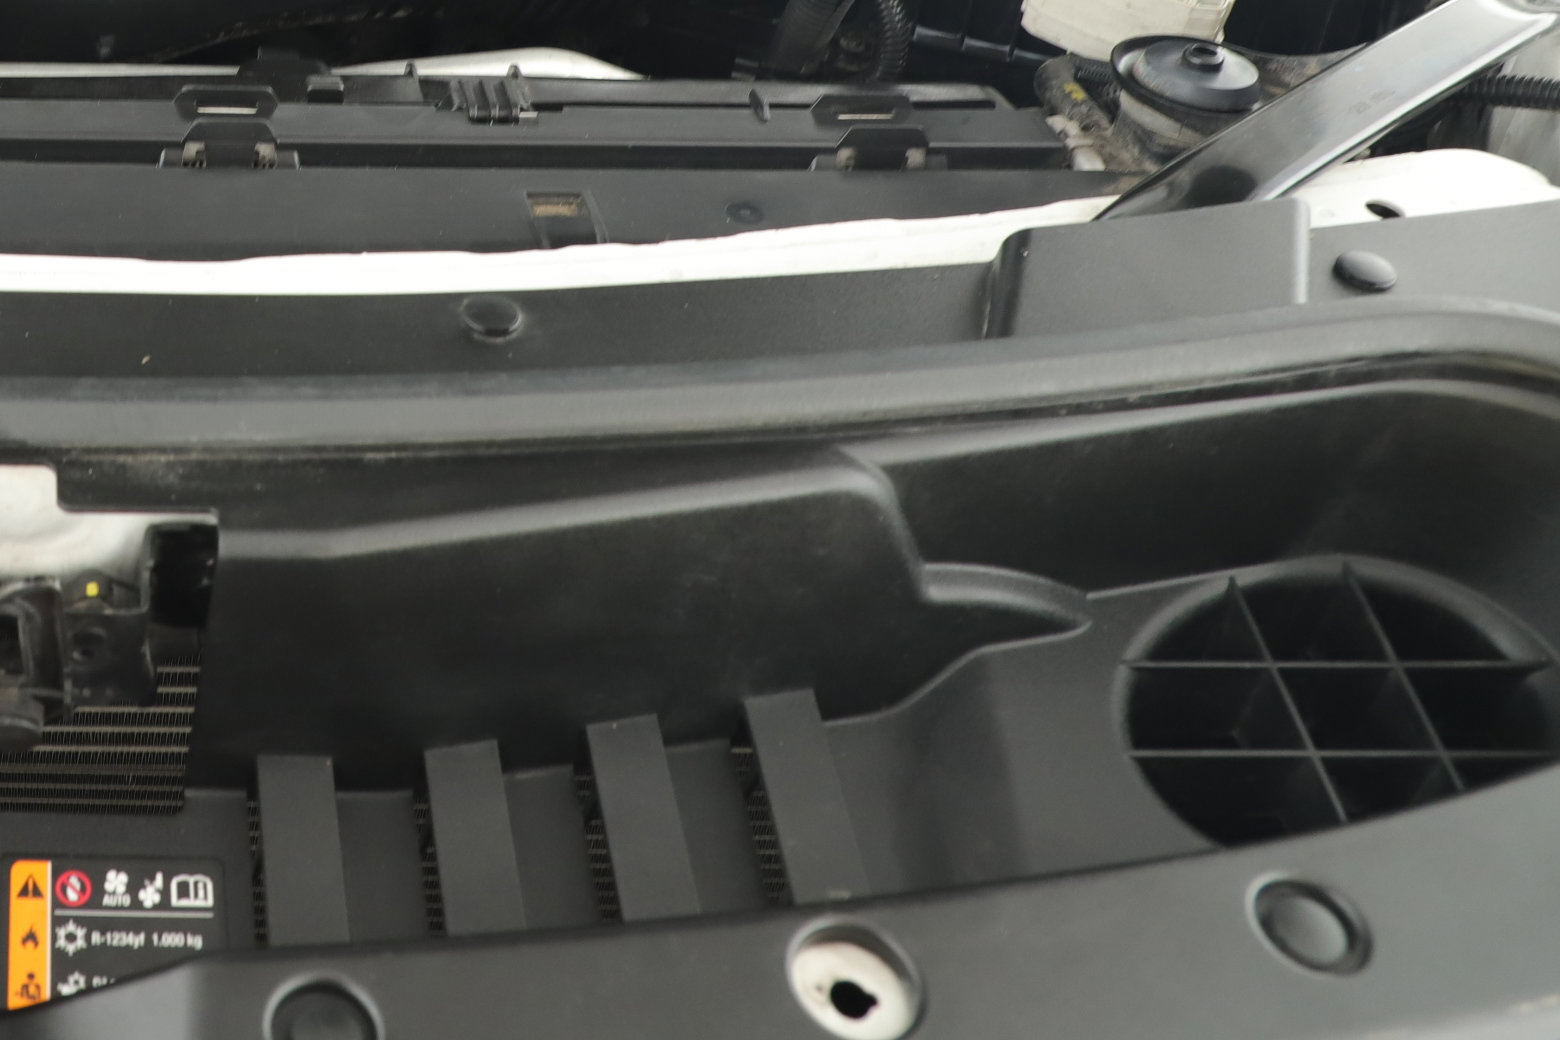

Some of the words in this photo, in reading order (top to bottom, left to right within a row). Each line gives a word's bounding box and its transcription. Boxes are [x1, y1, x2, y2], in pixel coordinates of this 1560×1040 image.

[102, 893, 131, 908] AUTO
[91, 930, 146, 950] R-1234yf
[152, 931, 185, 948] 1.000
[186, 931, 203, 951] kg
